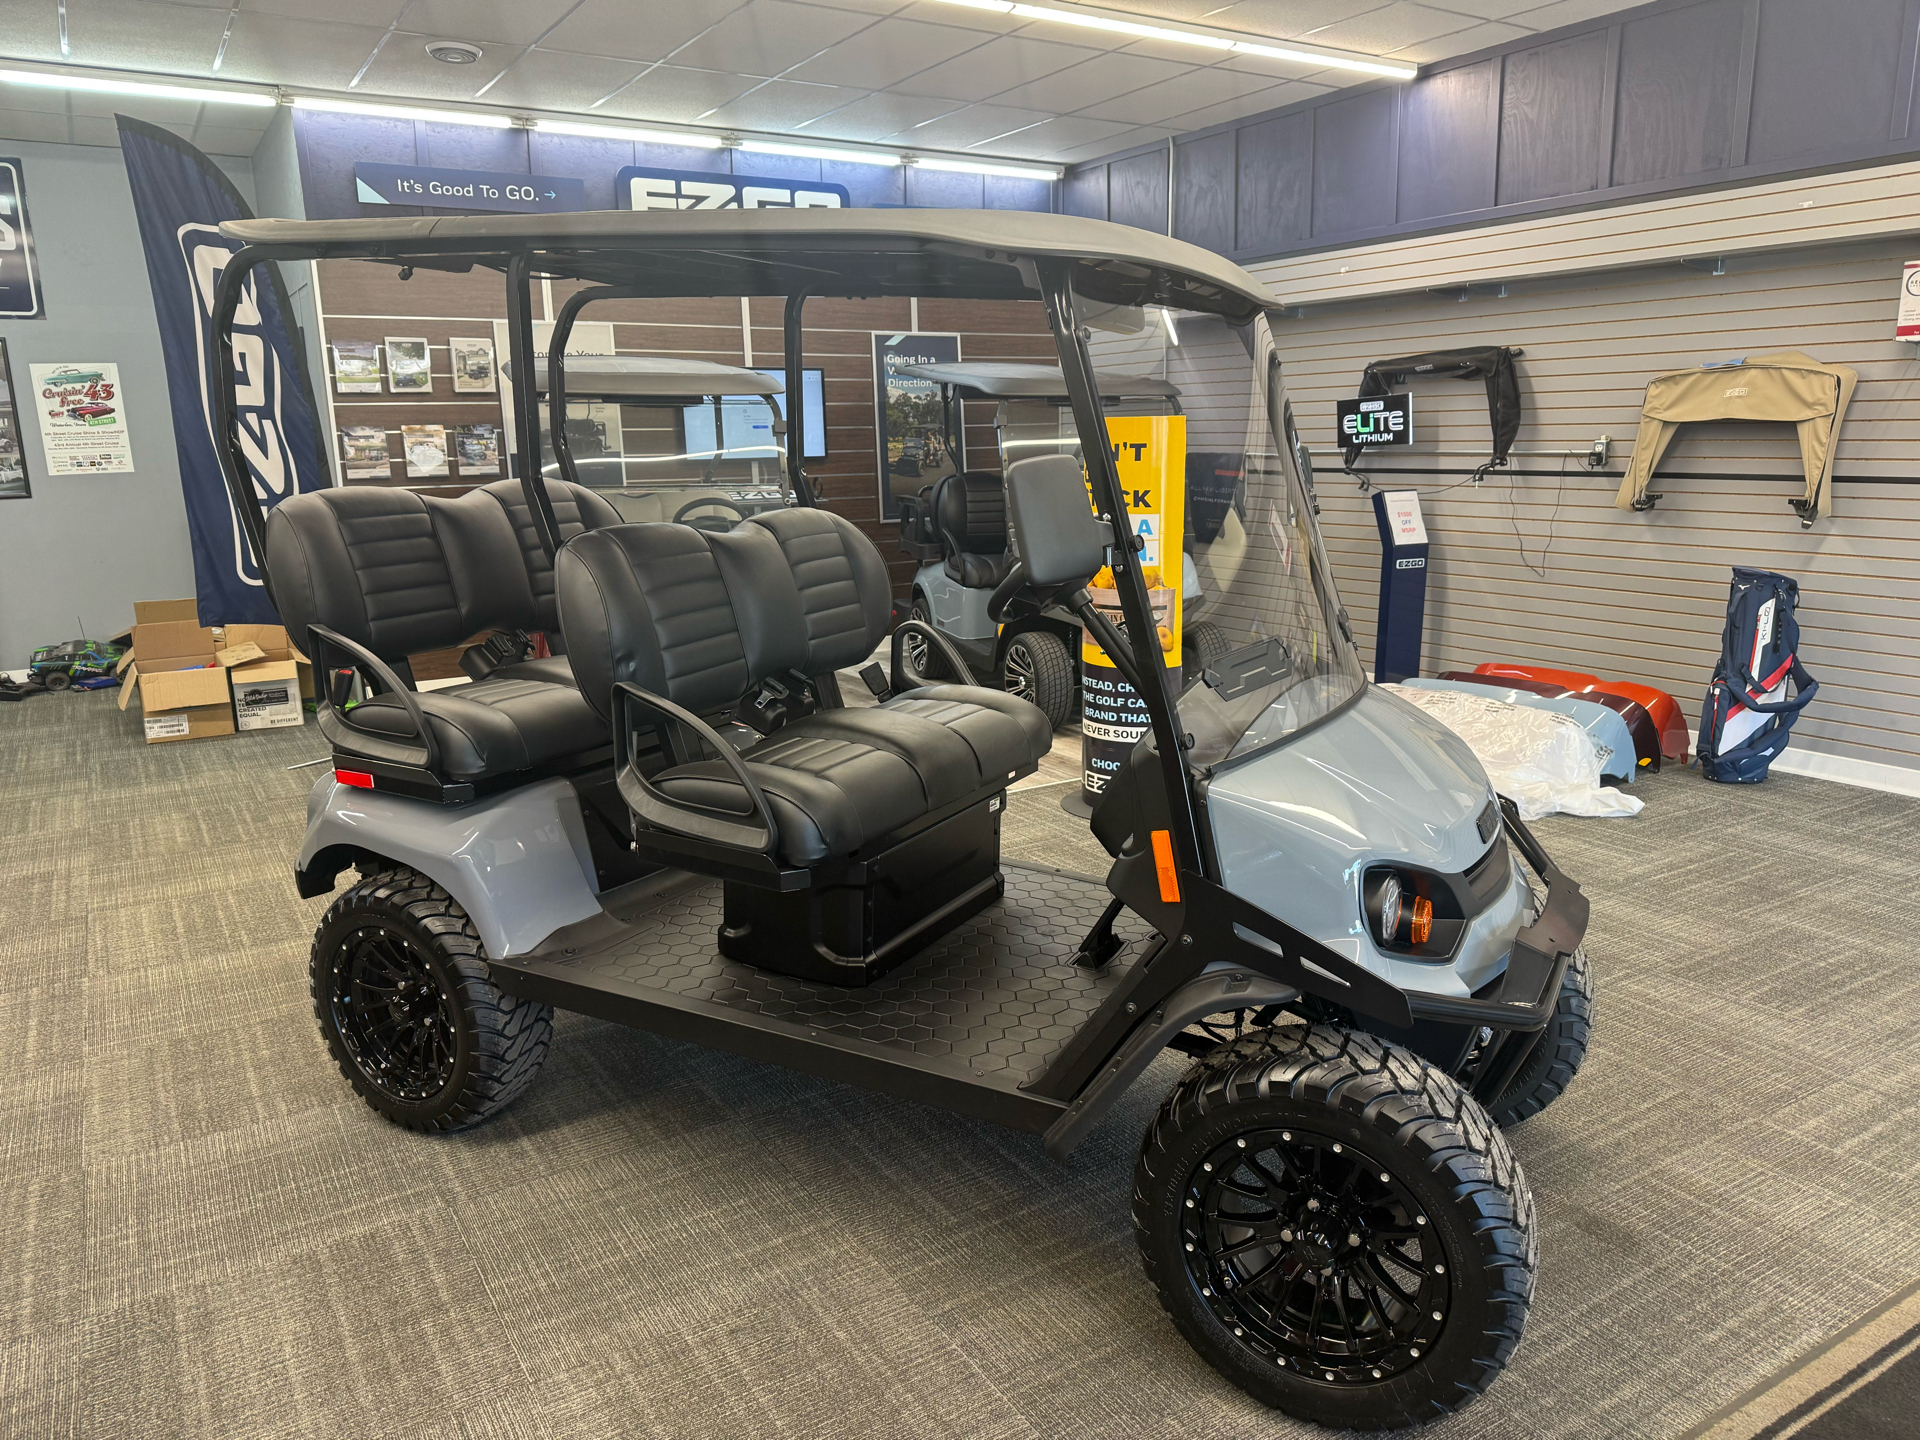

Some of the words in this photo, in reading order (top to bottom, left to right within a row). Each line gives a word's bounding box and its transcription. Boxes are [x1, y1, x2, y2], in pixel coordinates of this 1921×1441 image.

[397, 178, 423, 194] It's
[429, 181, 474, 197] Good
[479, 184, 499, 199] To
[505, 185, 540, 201] GO.
[887, 354, 916, 365] Going
[918, 354, 928, 364] In
[930, 356, 936, 364] a
[888, 378, 932, 387] Direction
[42, 385, 86, 399] Cruisin'
[83, 383, 115, 401] 43
[1352, 432, 1394, 444] LITHIUM
[1137, 519, 1153, 535] A
[1398, 559, 1424, 568] EZGO
[1082, 690, 1095, 703] THE
[1095, 694, 1126, 707] GOLF
[1127, 697, 1148, 708] CA
[1085, 706, 1118, 722] BRAND
[1119, 712, 1152, 724] THAT
